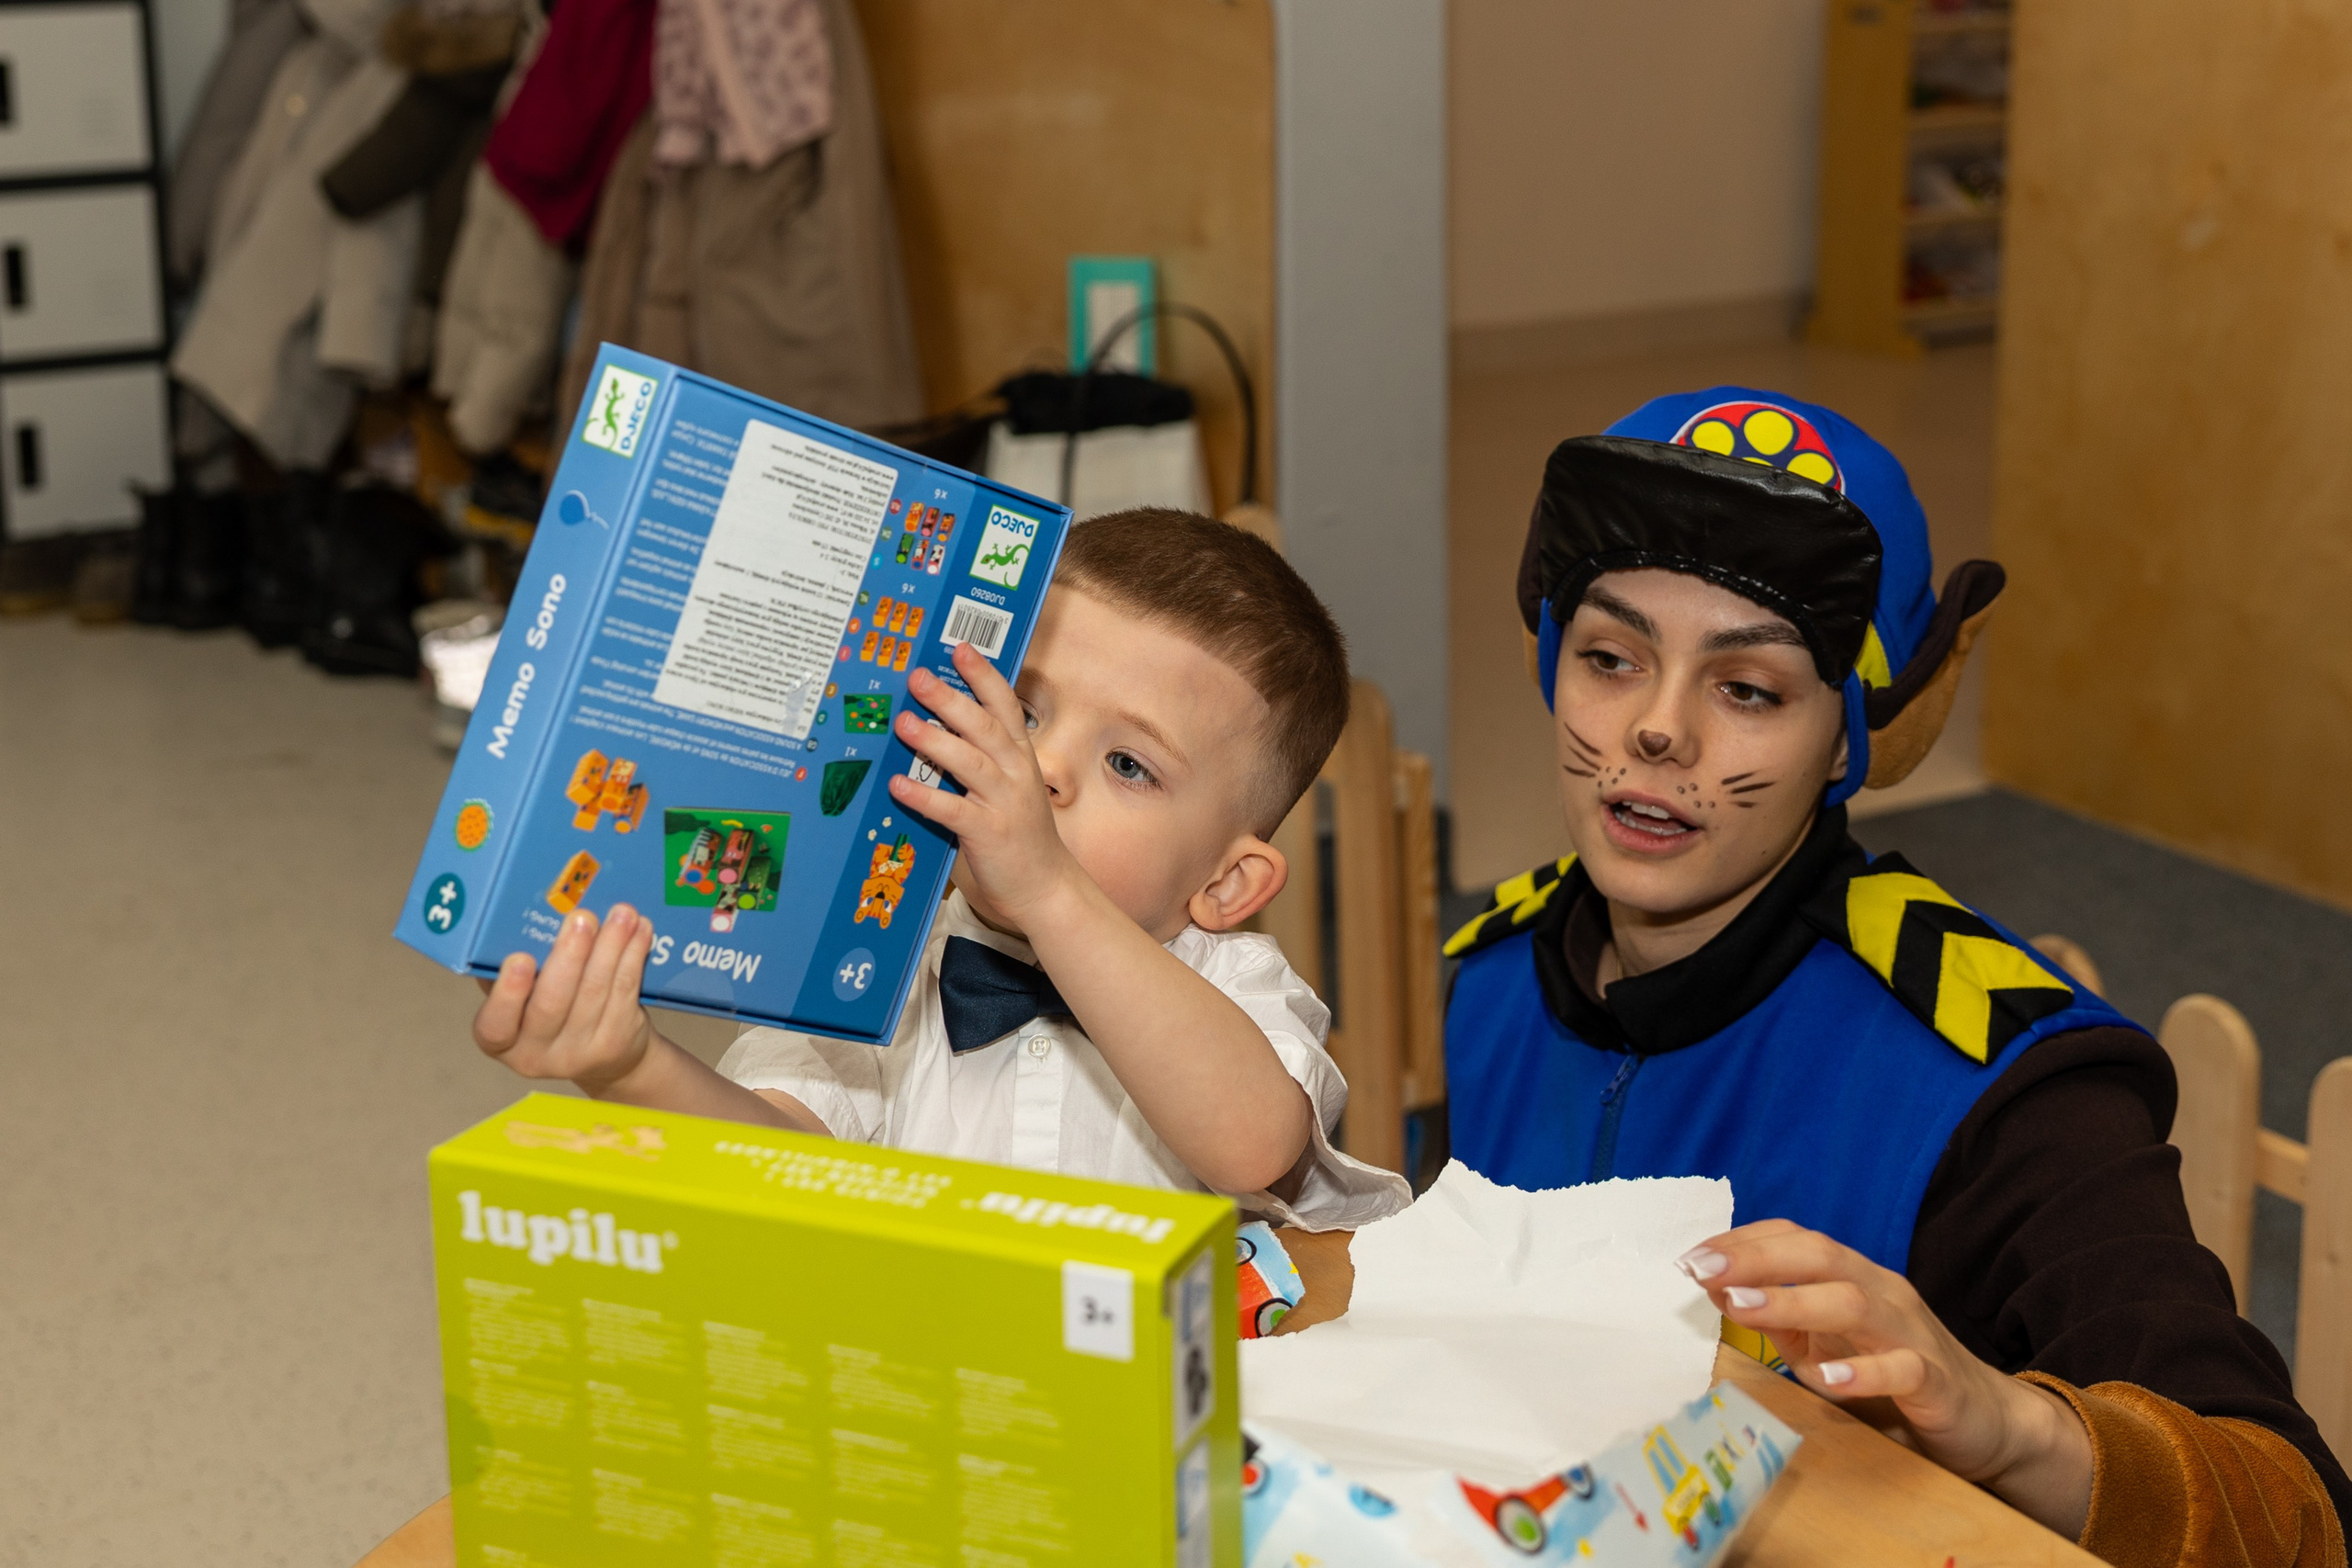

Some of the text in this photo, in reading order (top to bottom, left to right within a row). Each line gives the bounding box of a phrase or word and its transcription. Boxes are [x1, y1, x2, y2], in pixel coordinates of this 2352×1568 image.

[621, 380, 651, 451] DJECO
[933, 488, 948, 500] x6
[990, 511, 1035, 538] DJECO
[901, 582, 916, 594] x6
[970, 586, 1006, 606] DJ08260
[487, 573, 568, 760] Memo Sono
[428, 881, 458, 931] 3+
[682, 941, 762, 984] Memo
[840, 962, 872, 989] 3+
[458, 1190, 664, 1275] lupilu
